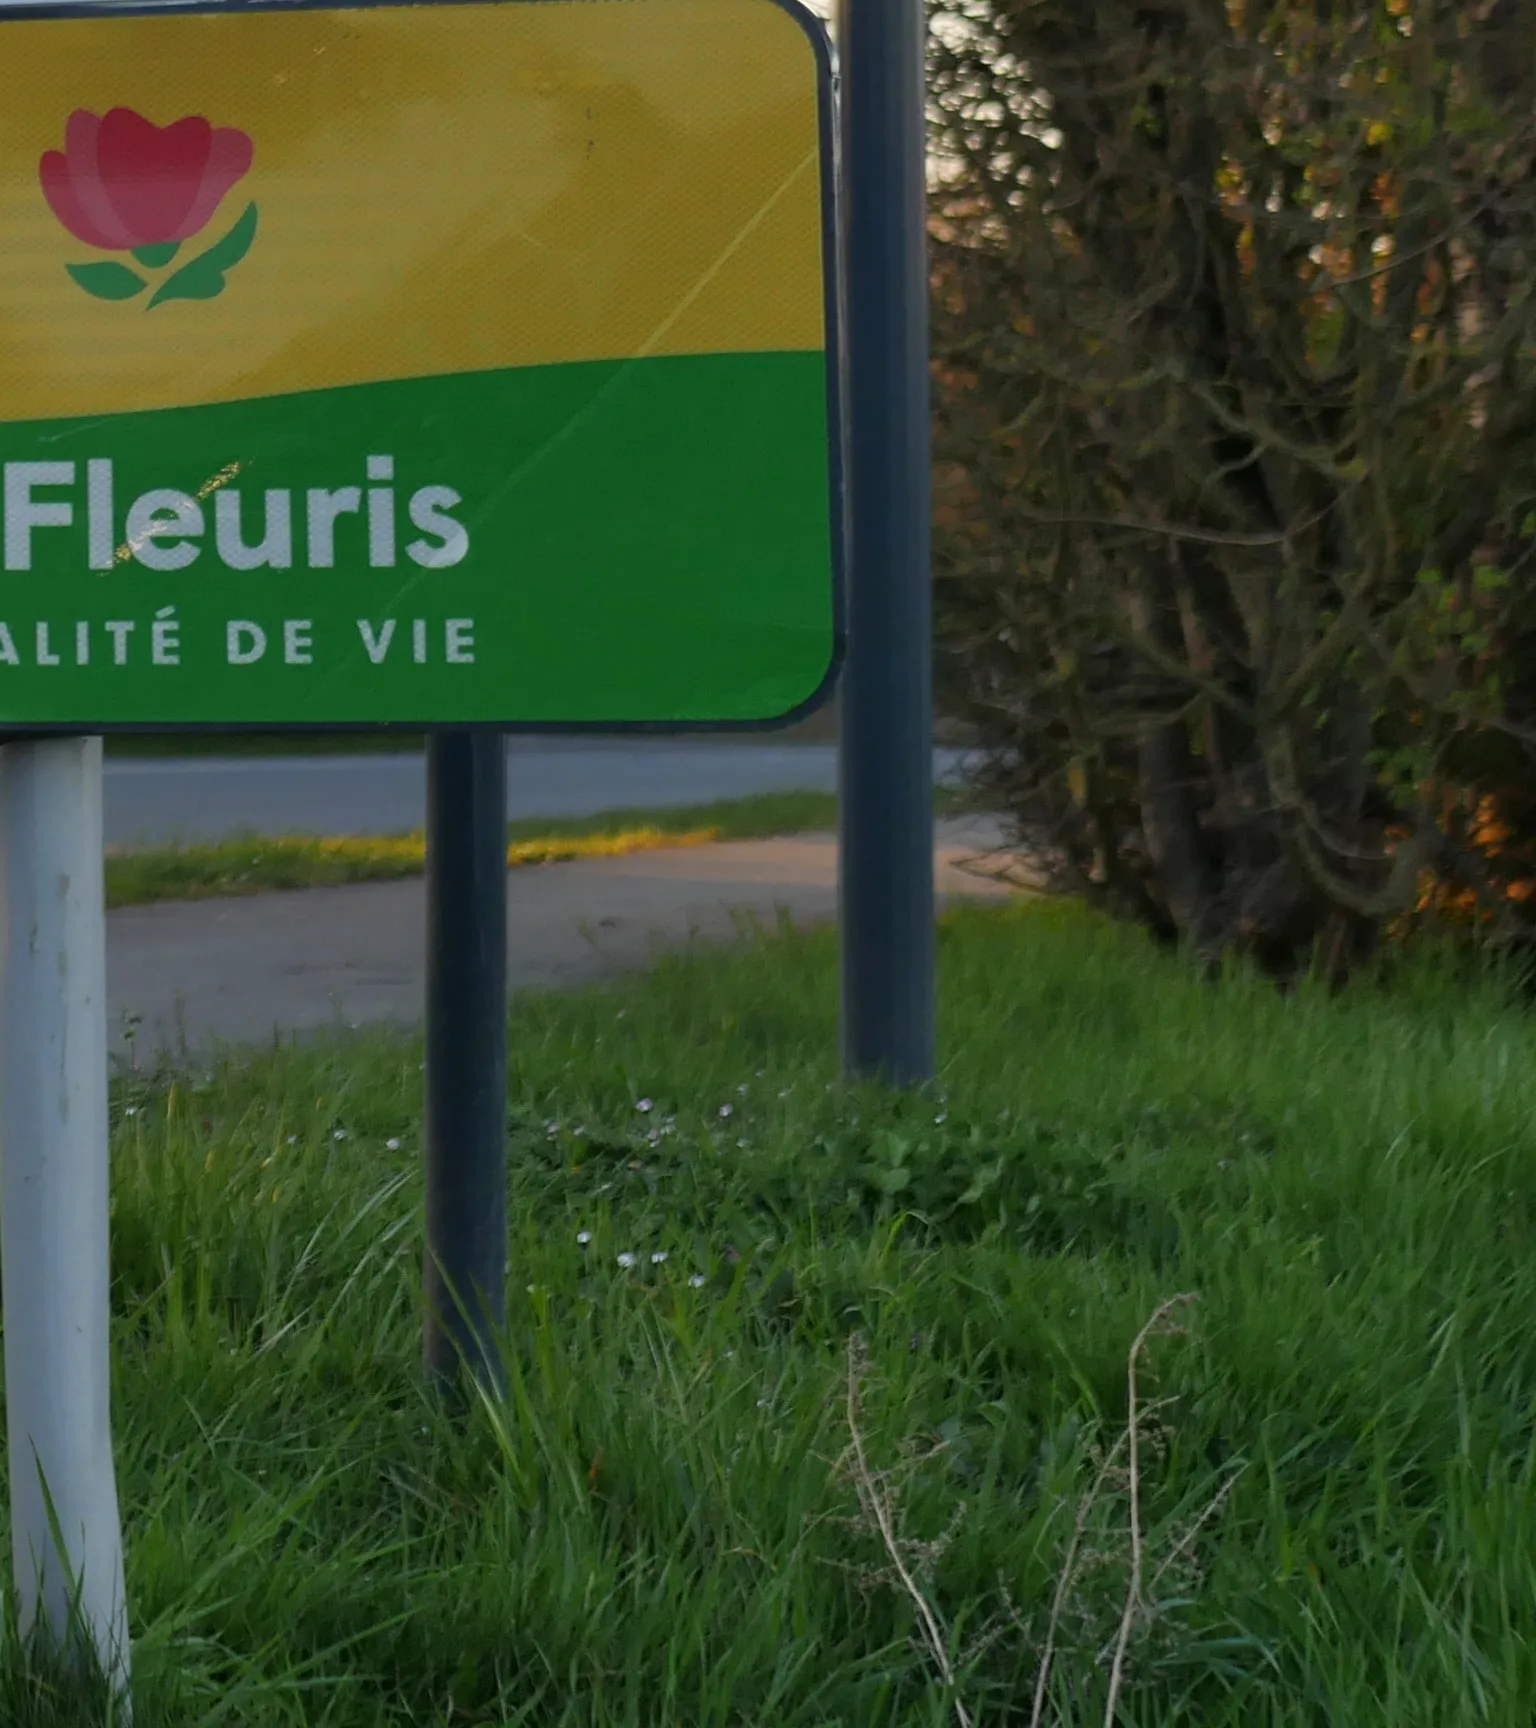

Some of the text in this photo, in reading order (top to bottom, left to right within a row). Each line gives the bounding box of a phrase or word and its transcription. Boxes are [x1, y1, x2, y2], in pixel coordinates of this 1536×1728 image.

[3, 454, 470, 571] Fleuris
[226, 619, 313, 665] DE
[356, 618, 475, 664] VIE
